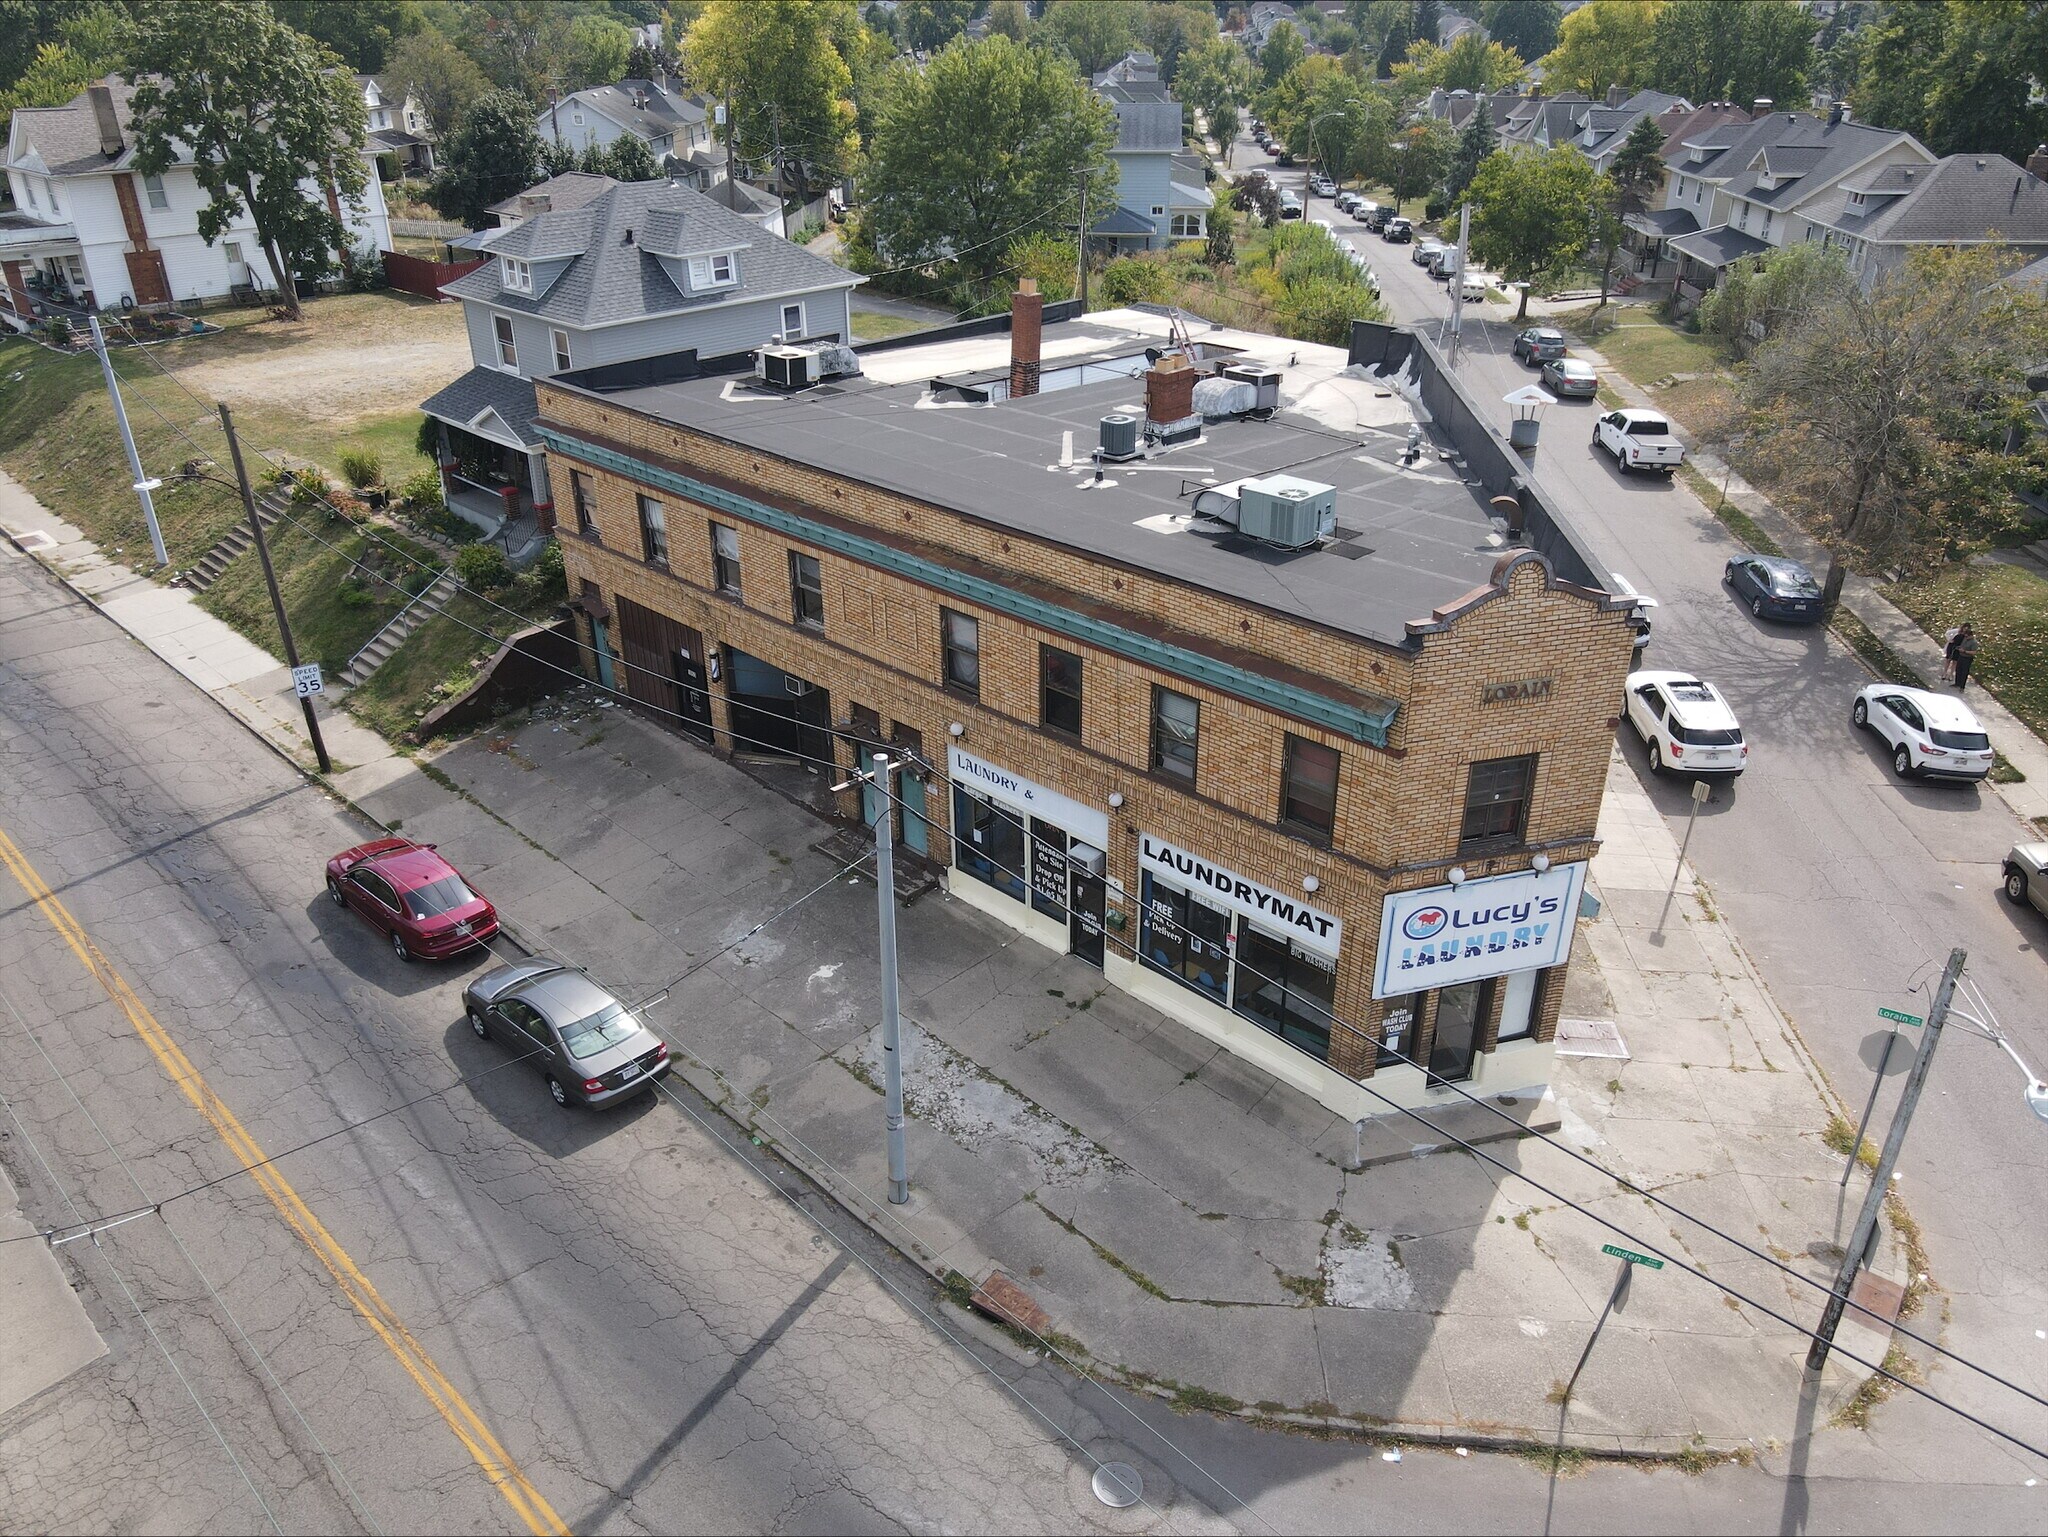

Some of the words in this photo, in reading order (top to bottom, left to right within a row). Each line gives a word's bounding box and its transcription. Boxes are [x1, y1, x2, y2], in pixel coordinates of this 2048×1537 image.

[294, 666, 318, 677] SPEED
[298, 673, 317, 682] LIMIT
[298, 680, 321, 693] 35
[1482, 680, 1553, 703] LORAIN
[957, 753, 1018, 792] LAUNDRY
[1024, 789, 1034, 801] &
[1143, 839, 1334, 938] LAUNDRYMAT
[1152, 898, 1173, 918] FREE
[1152, 922, 1183, 944] Delivery
[1401, 923, 1550, 970] LAUNDRY
[1304, 952, 1337, 975] WASHERS
[1389, 1008, 1408, 1018] Join
[1399, 1013, 1413, 1023] CLUB
[1879, 1008, 1909, 1022] Lorain
[1385, 1022, 1408, 1033] TODAY
[1606, 1246, 1642, 1262] Linden
